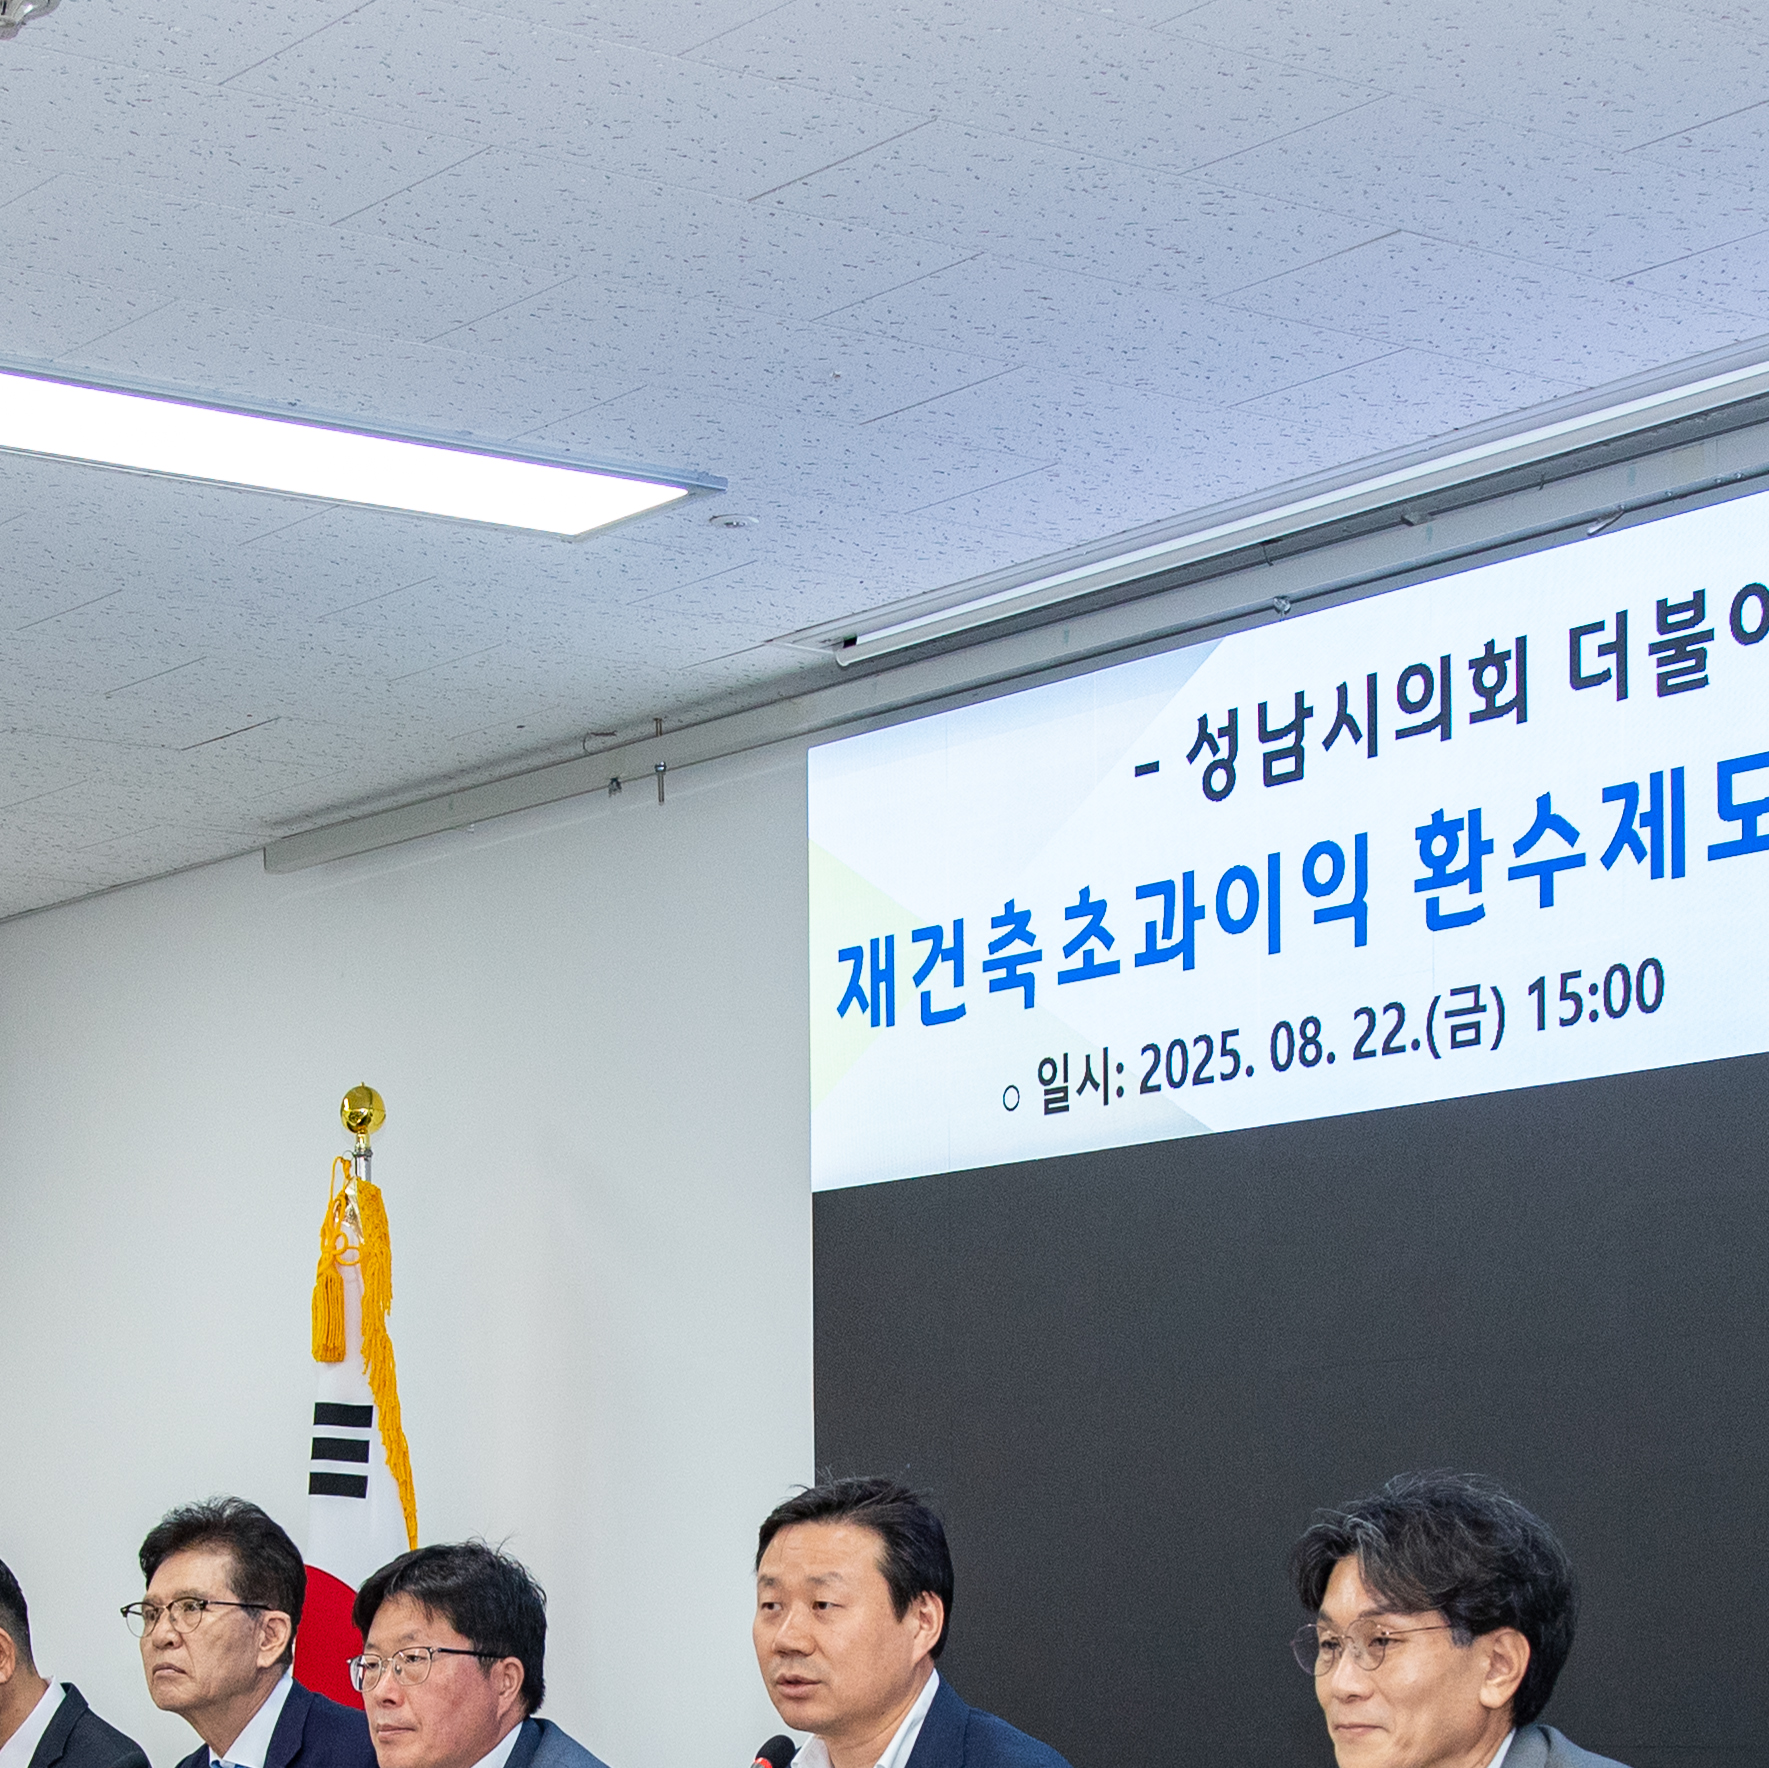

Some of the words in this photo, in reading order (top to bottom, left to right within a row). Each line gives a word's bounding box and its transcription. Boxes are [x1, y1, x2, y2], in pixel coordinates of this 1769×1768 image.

[1185, 634, 1529, 804] 성남시의회
[836, 831, 1369, 1028] 재건축초과이익
[1037, 1046, 1125, 1116] 일시:
[1139, 1027, 1255, 1095] 2025.
[1270, 1015, 1336, 1073] 08.
[1352, 983, 1506, 1061] 22.(금)
[1527, 956, 1666, 1032] 15:00
